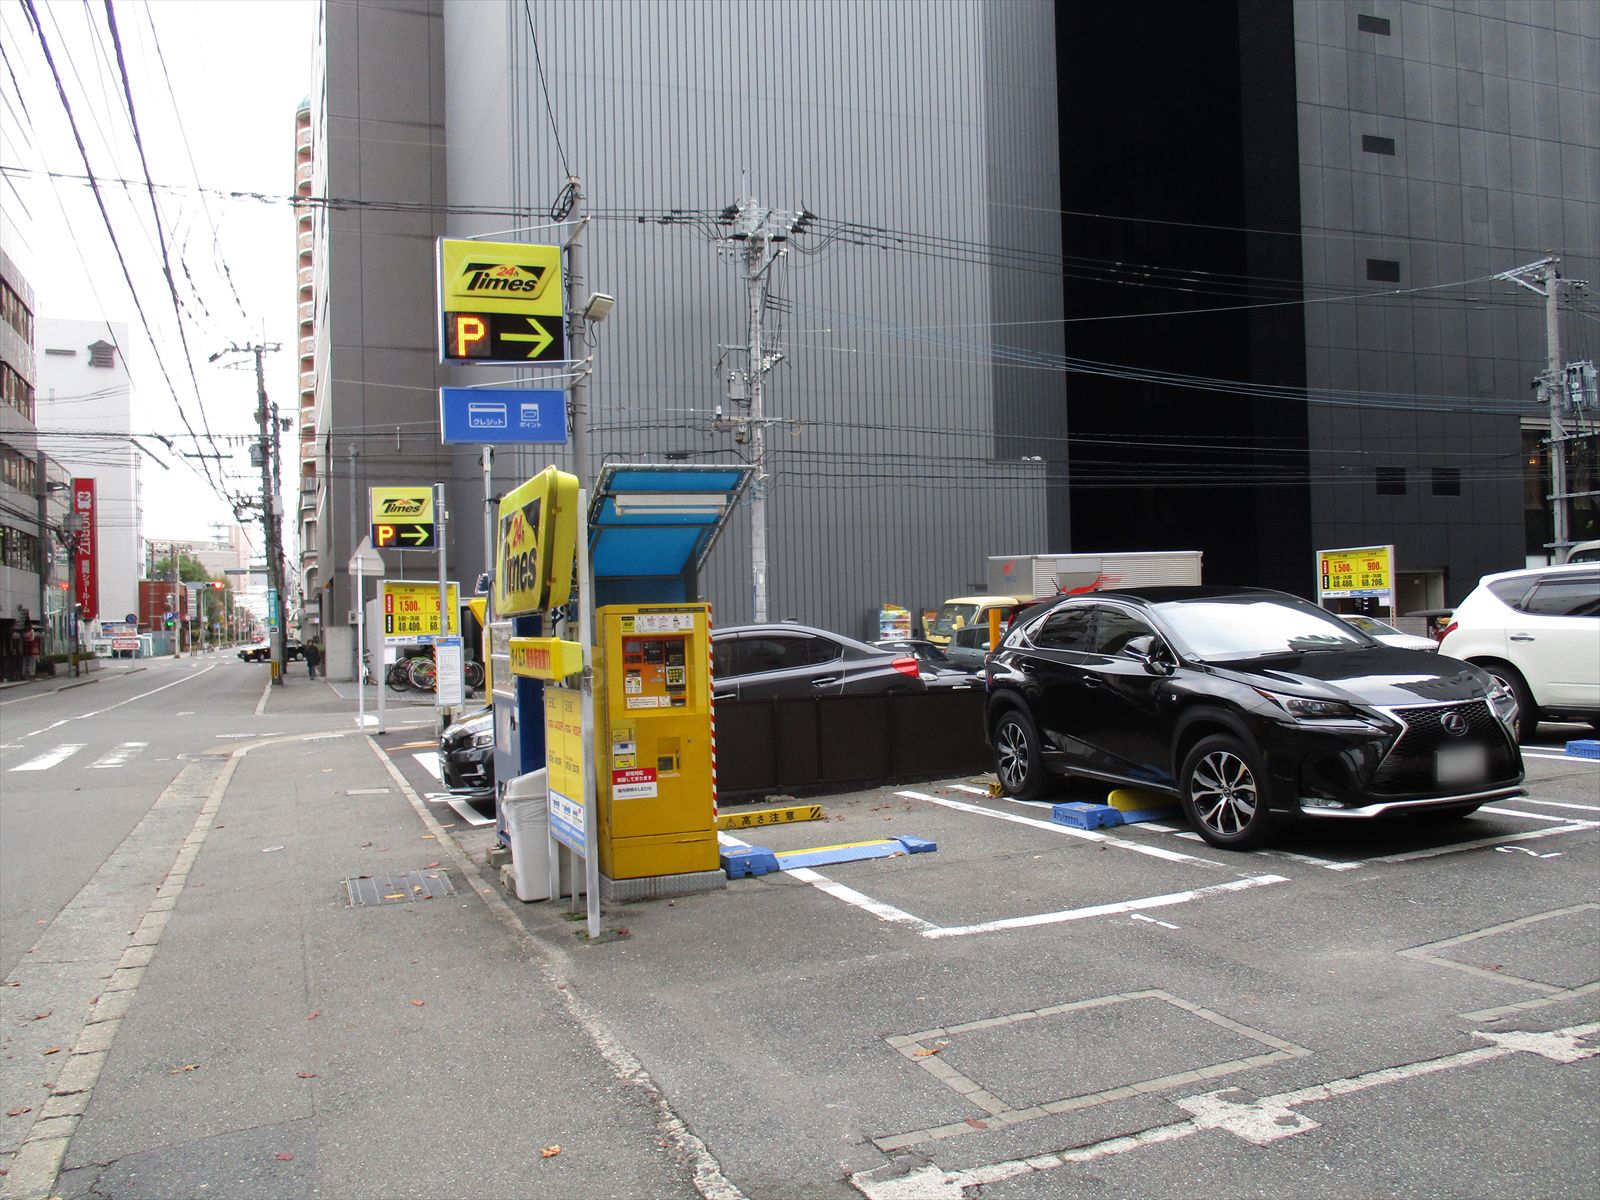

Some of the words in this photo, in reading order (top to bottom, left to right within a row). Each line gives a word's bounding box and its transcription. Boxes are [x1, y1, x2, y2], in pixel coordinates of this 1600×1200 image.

[464, 264, 538, 292] Times
[457, 317, 485, 356] P
[473, 418, 504, 426] クレジット
[519, 421, 542, 429] ポイント
[382, 499, 421, 514] Times
[378, 525, 394, 546] P
[741, 811, 796, 826] 高さ注意
